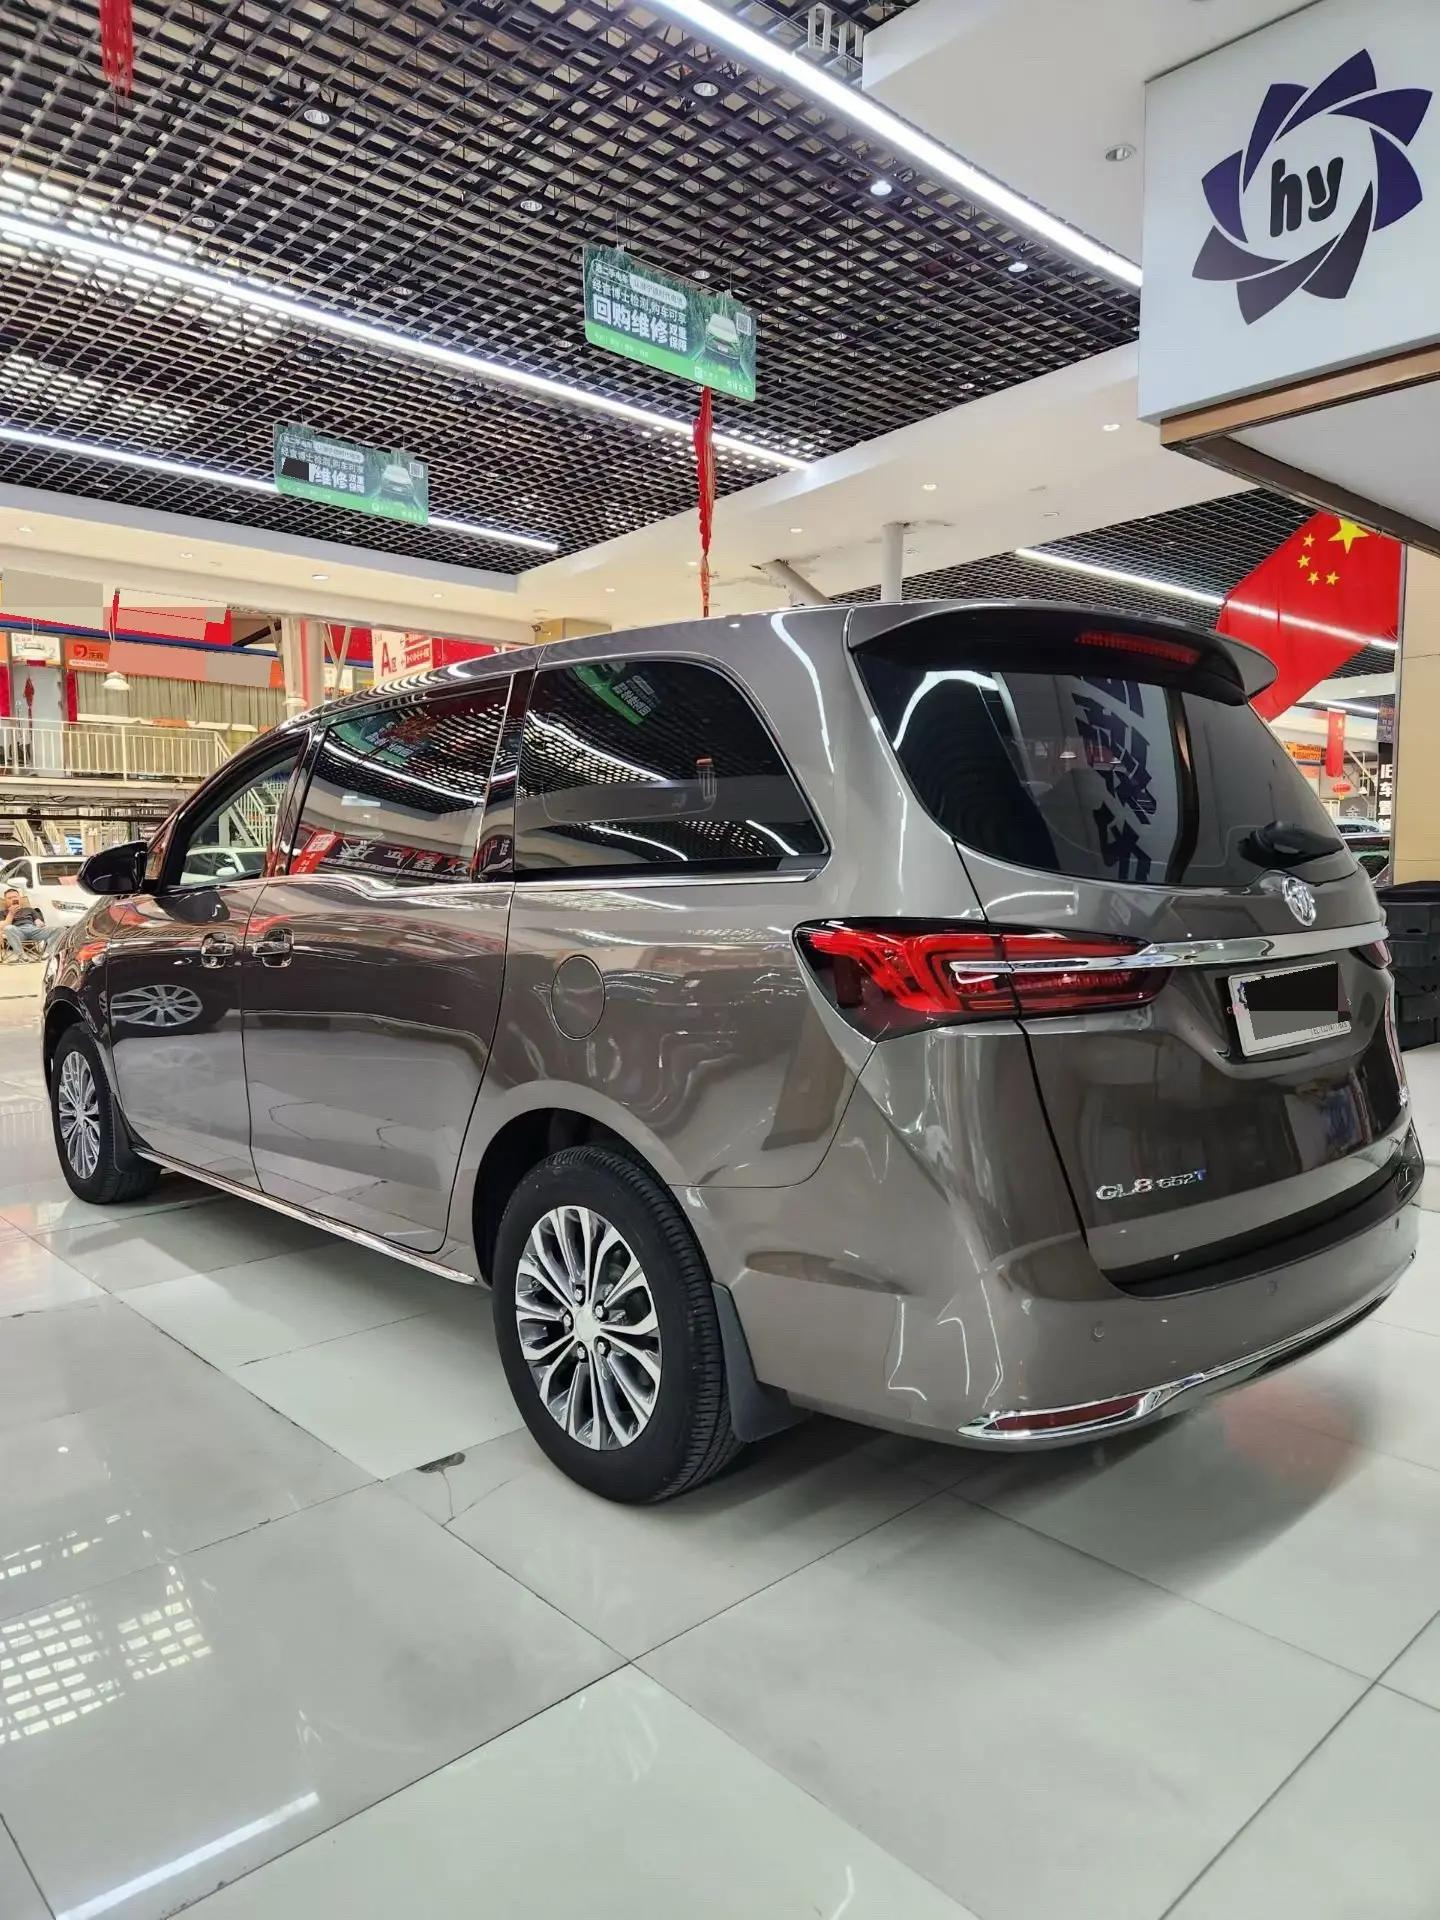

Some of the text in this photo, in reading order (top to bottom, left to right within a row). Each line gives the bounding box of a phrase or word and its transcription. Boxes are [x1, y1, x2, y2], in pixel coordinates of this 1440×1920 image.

[1270, 157, 1344, 238] hy
[592, 293, 668, 344] 回购维修
[1096, 1178, 1153, 1200] GL8
